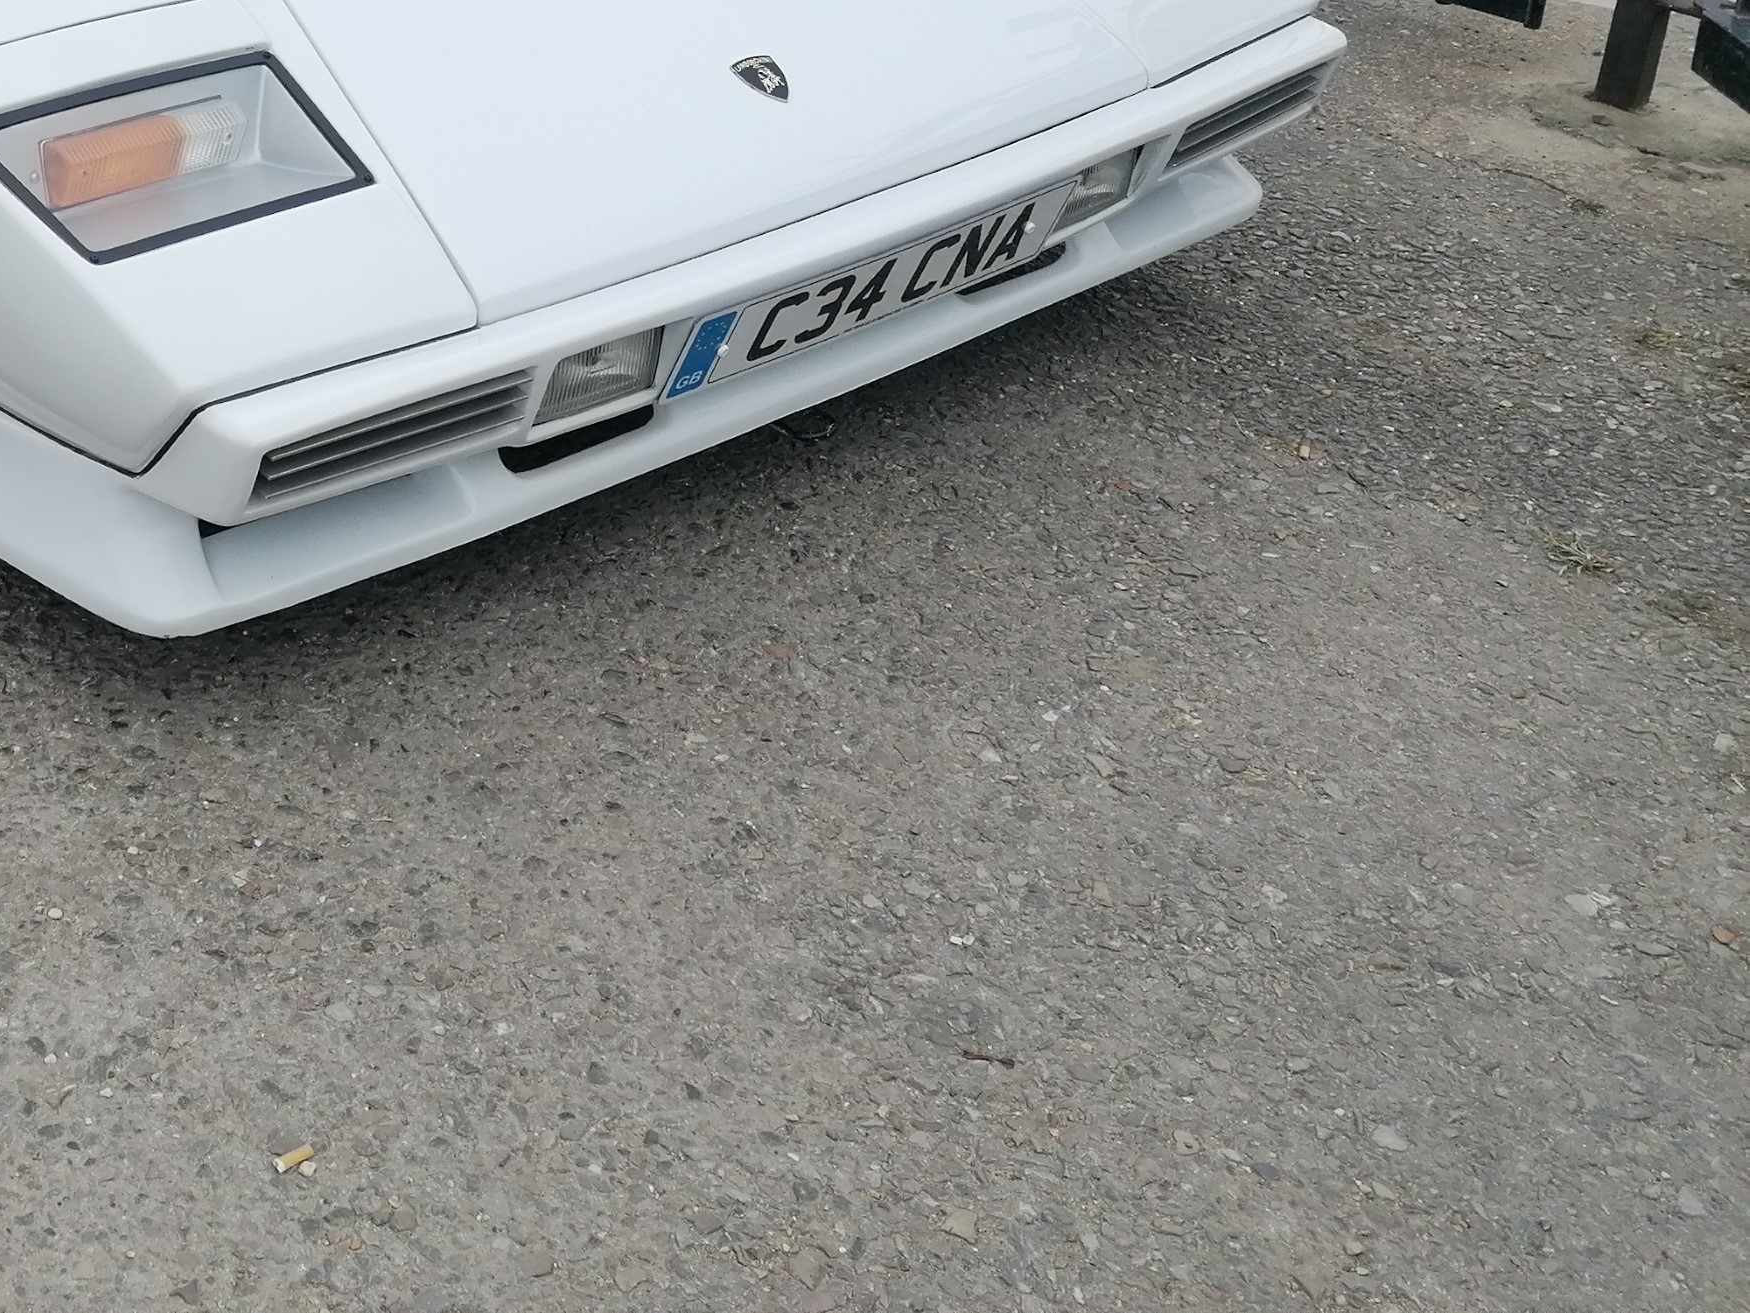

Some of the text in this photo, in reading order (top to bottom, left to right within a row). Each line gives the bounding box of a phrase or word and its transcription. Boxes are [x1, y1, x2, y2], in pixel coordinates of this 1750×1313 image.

[745, 201, 1036, 362] C34 CNA
[675, 371, 703, 390] GB
